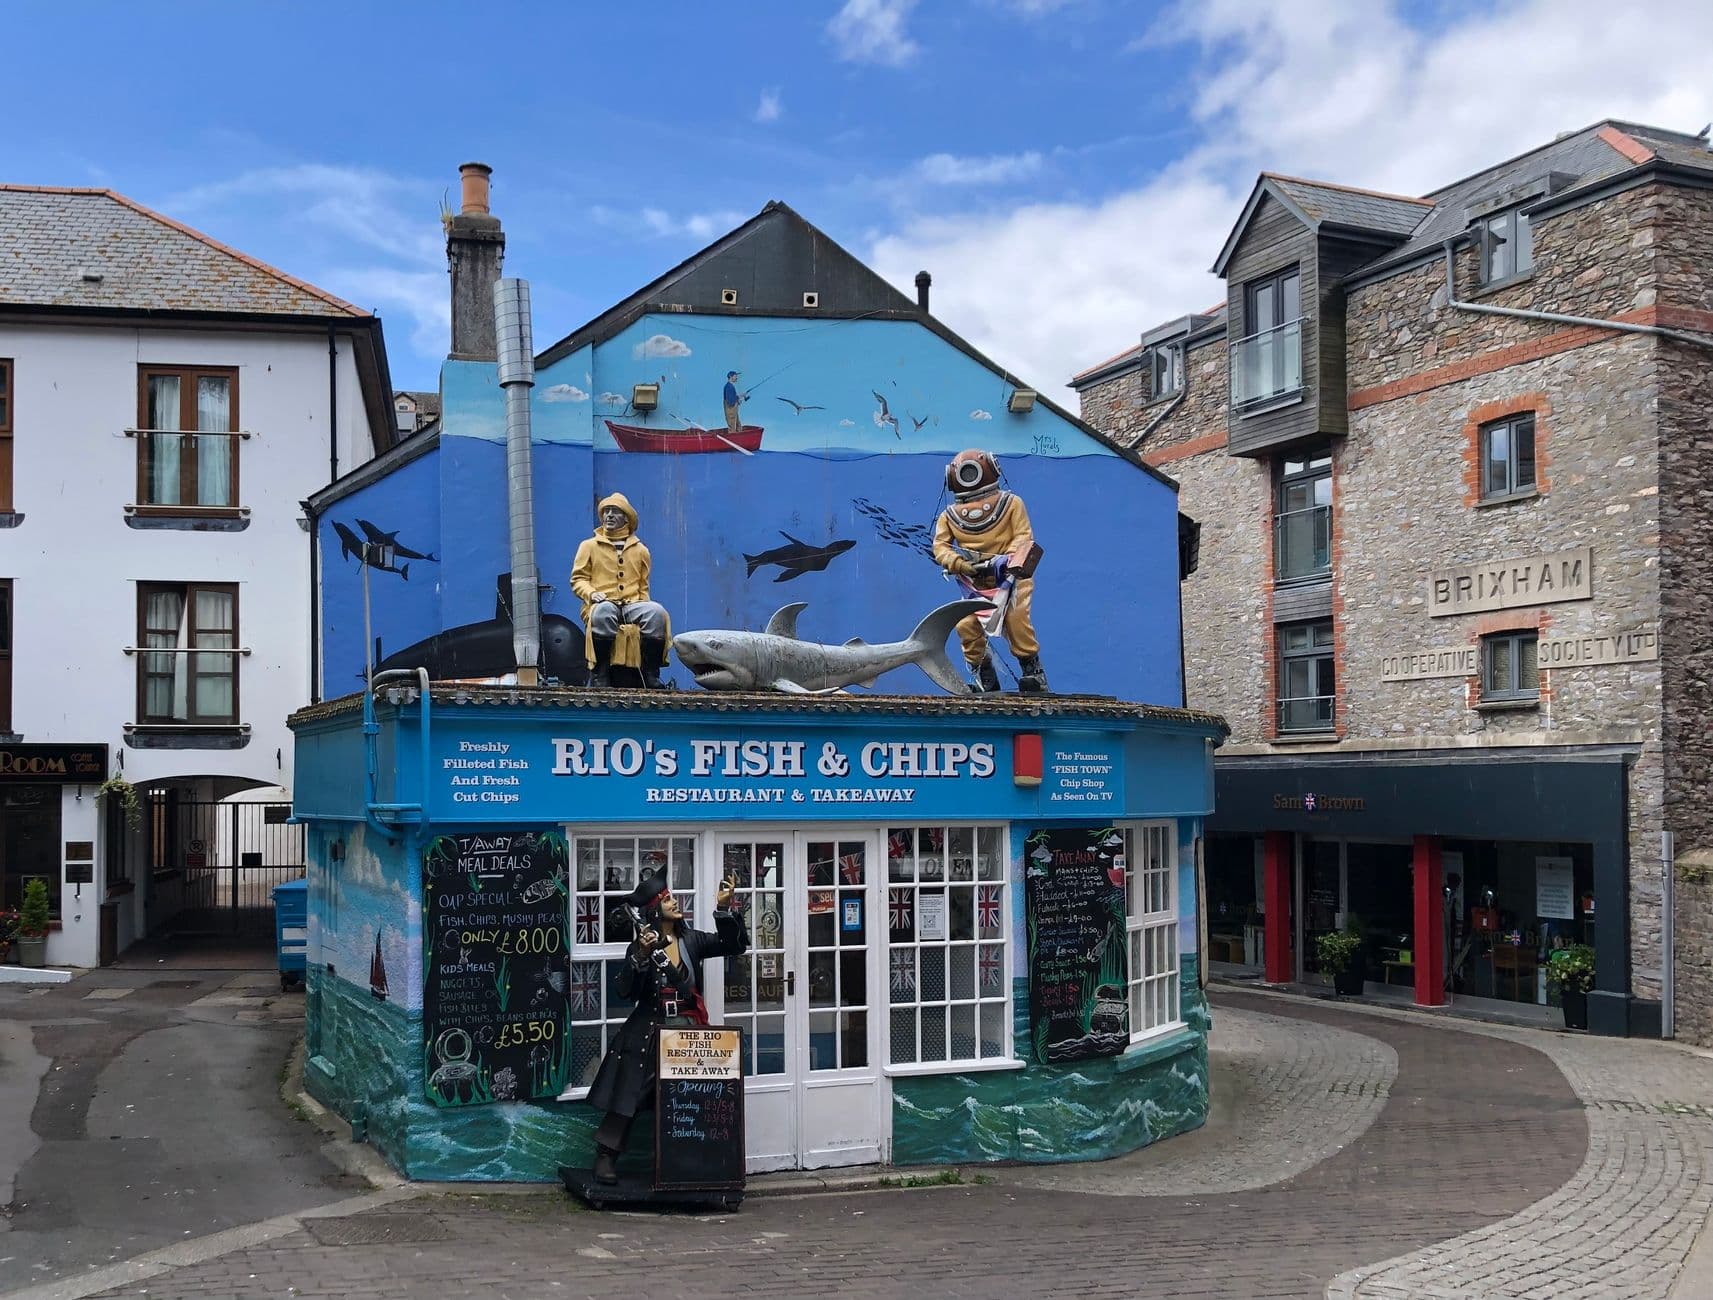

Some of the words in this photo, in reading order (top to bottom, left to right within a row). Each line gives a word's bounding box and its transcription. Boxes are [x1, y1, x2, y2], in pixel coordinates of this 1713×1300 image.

[1434, 559, 1583, 605] BRIXHAM
[1539, 635, 1622, 663] SOCIETY
[459, 741, 510, 754] Freshly
[551, 738, 677, 777] RIO's
[690, 740, 806, 778] FISH
[817, 741, 848, 777] &
[861, 742, 996, 778] CHIPS
[1055, 752, 1073, 761] The
[1075, 752, 1109, 761] Famous
[443, 758, 496, 770] Filleted
[499, 758, 529, 770] Fish
[451, 775, 479, 787] And
[483, 774, 520, 787] Fresh
[1060, 779, 1081, 789] Chip
[1083, 779, 1105, 789] Shop
[453, 792, 479, 803] Cut
[481, 791, 520, 805] Chips
[646, 788, 784, 803] RESTAURANT
[791, 788, 805, 803] &
[811, 788, 915, 803] TAKEAWAY
[1050, 792, 1062, 801] As
[1064, 792, 1085, 801] Seen
[1087, 792, 1099, 801] On
[1100, 792, 1113, 801] TV
[1273, 793, 1303, 809] Sam
[1318, 794, 1367, 810] Brown
[458, 857, 487, 872] MEAL
[492, 854, 531, 871] DEALS
[438, 893, 464, 909] OAP
[502, 914, 533, 926] MUSHY
[537, 913, 562, 924] PEAS
[461, 929, 500, 944] ONLY
[497, 927, 560, 954] £8.00
[440, 964, 464, 975] KIDS
[466, 962, 495, 972] MEALS
[494, 1020, 555, 1050] £5.50
[678, 1032, 700, 1040] THE
[703, 1032, 722, 1040] RIO
[667, 1049, 734, 1057] RESTAURANT
[671, 1067, 699, 1075] TAKE
[701, 1067, 730, 1075] AWAY
[677, 1080, 725, 1098] Opening
[673, 1111, 696, 1125] Friday
[672, 1126, 705, 1141] Saturday
